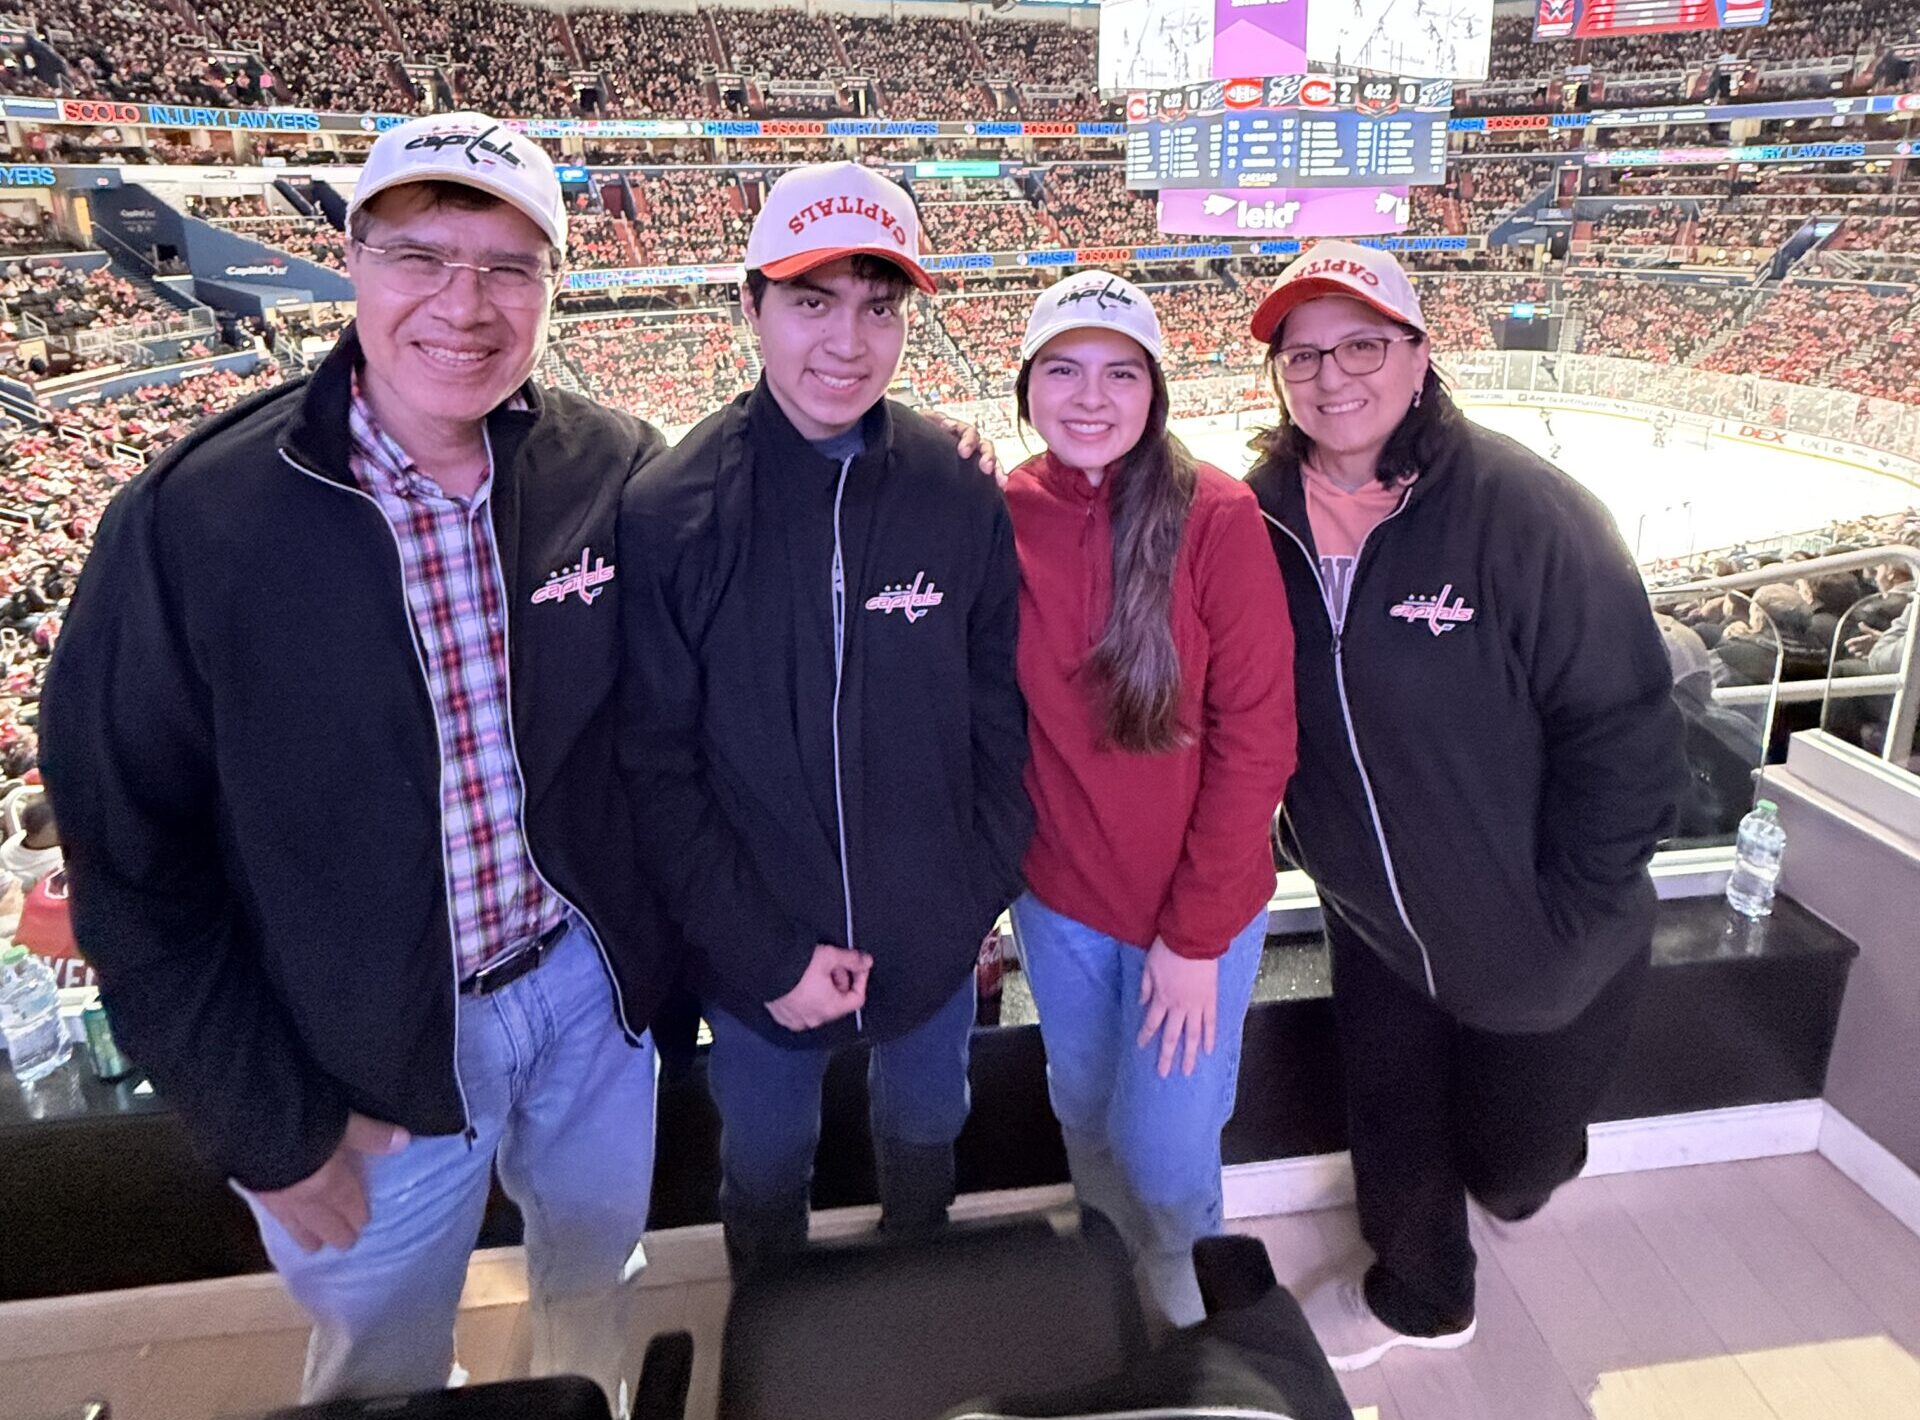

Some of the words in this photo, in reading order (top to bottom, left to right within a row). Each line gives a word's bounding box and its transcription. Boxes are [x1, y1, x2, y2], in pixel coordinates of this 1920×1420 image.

[149, 104, 219, 127] INJURY
[225, 111, 321, 131] LAWYERS
[877, 122, 939, 135] LAWYERS
[1787, 143, 1865, 158] LAWYERS
[0, 165, 56, 186] YERS
[789, 196, 906, 245] CAPITALS
[1404, 238, 1467, 250] LAWYERS
[930, 255, 994, 270] LAWYERS
[1294, 259, 1379, 286] CAPIT
[531, 547, 615, 604] capitals
[865, 571, 944, 623] capitals
[1389, 584, 1475, 636] capitals
